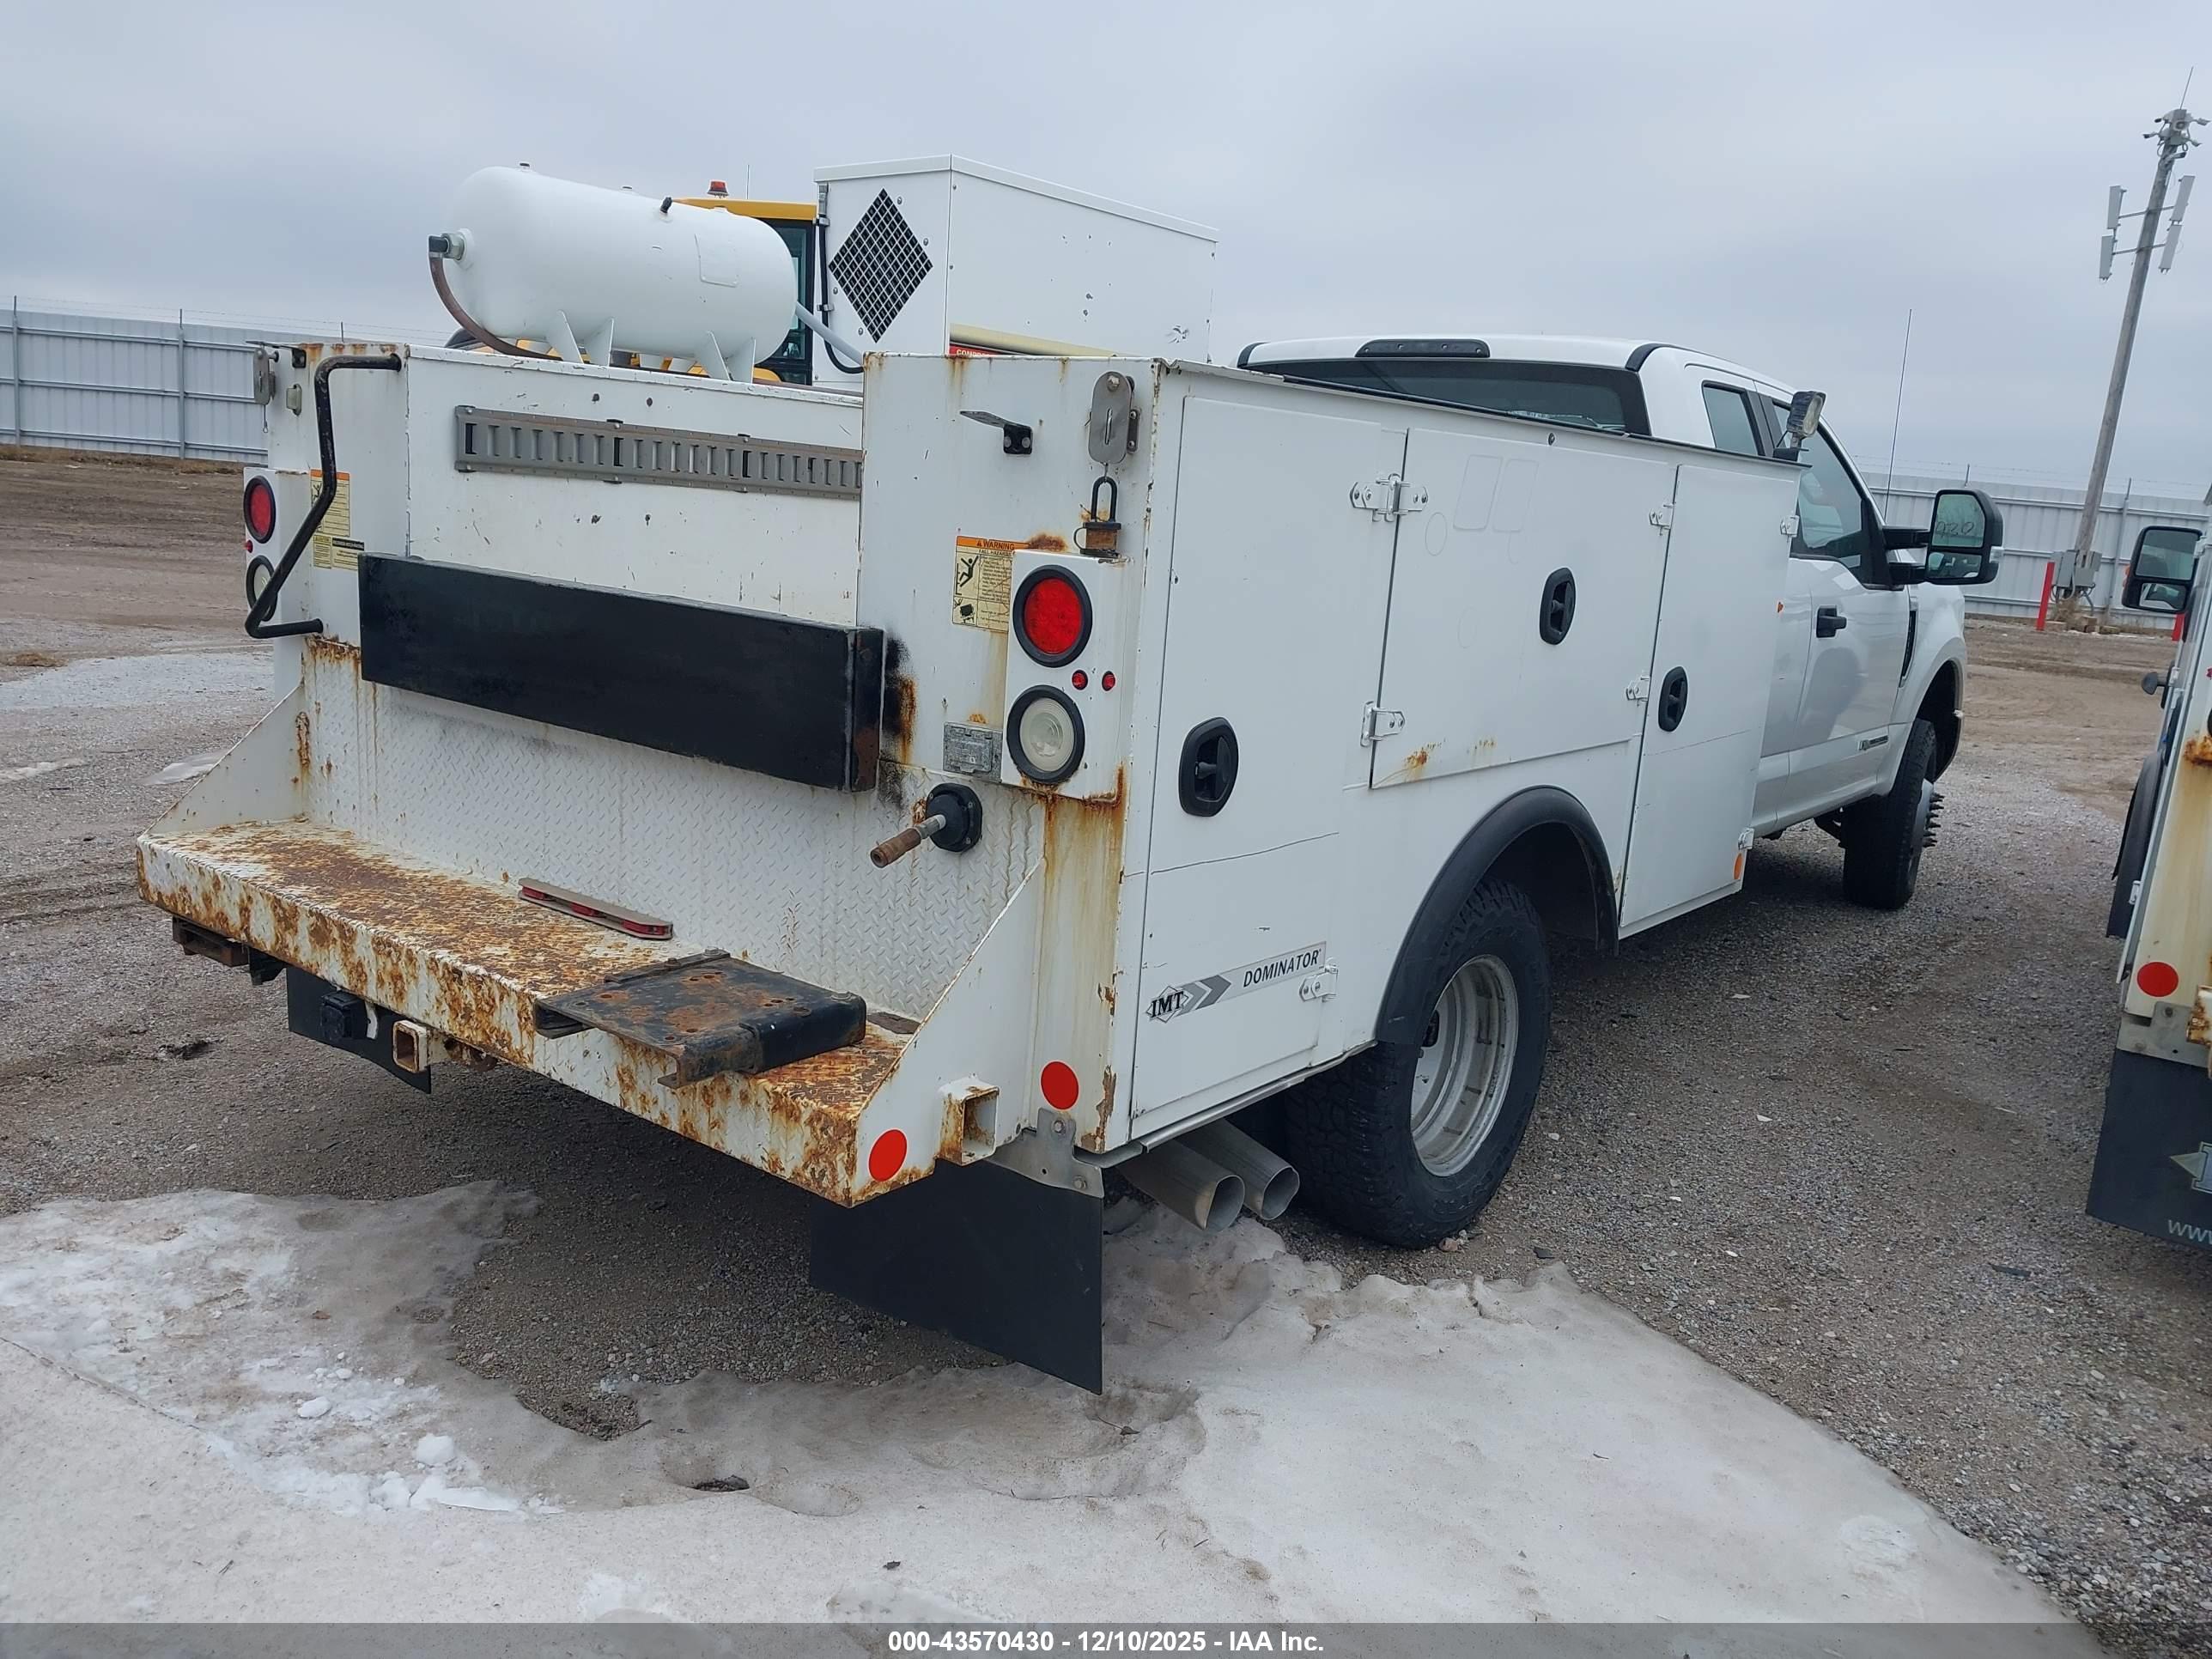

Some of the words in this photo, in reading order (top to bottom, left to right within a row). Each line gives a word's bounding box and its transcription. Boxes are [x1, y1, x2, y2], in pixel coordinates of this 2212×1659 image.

[983, 540, 1014, 550] WARNING
[1243, 949, 1320, 988] DOMINATOR
[1150, 990, 1184, 1019] IMT
